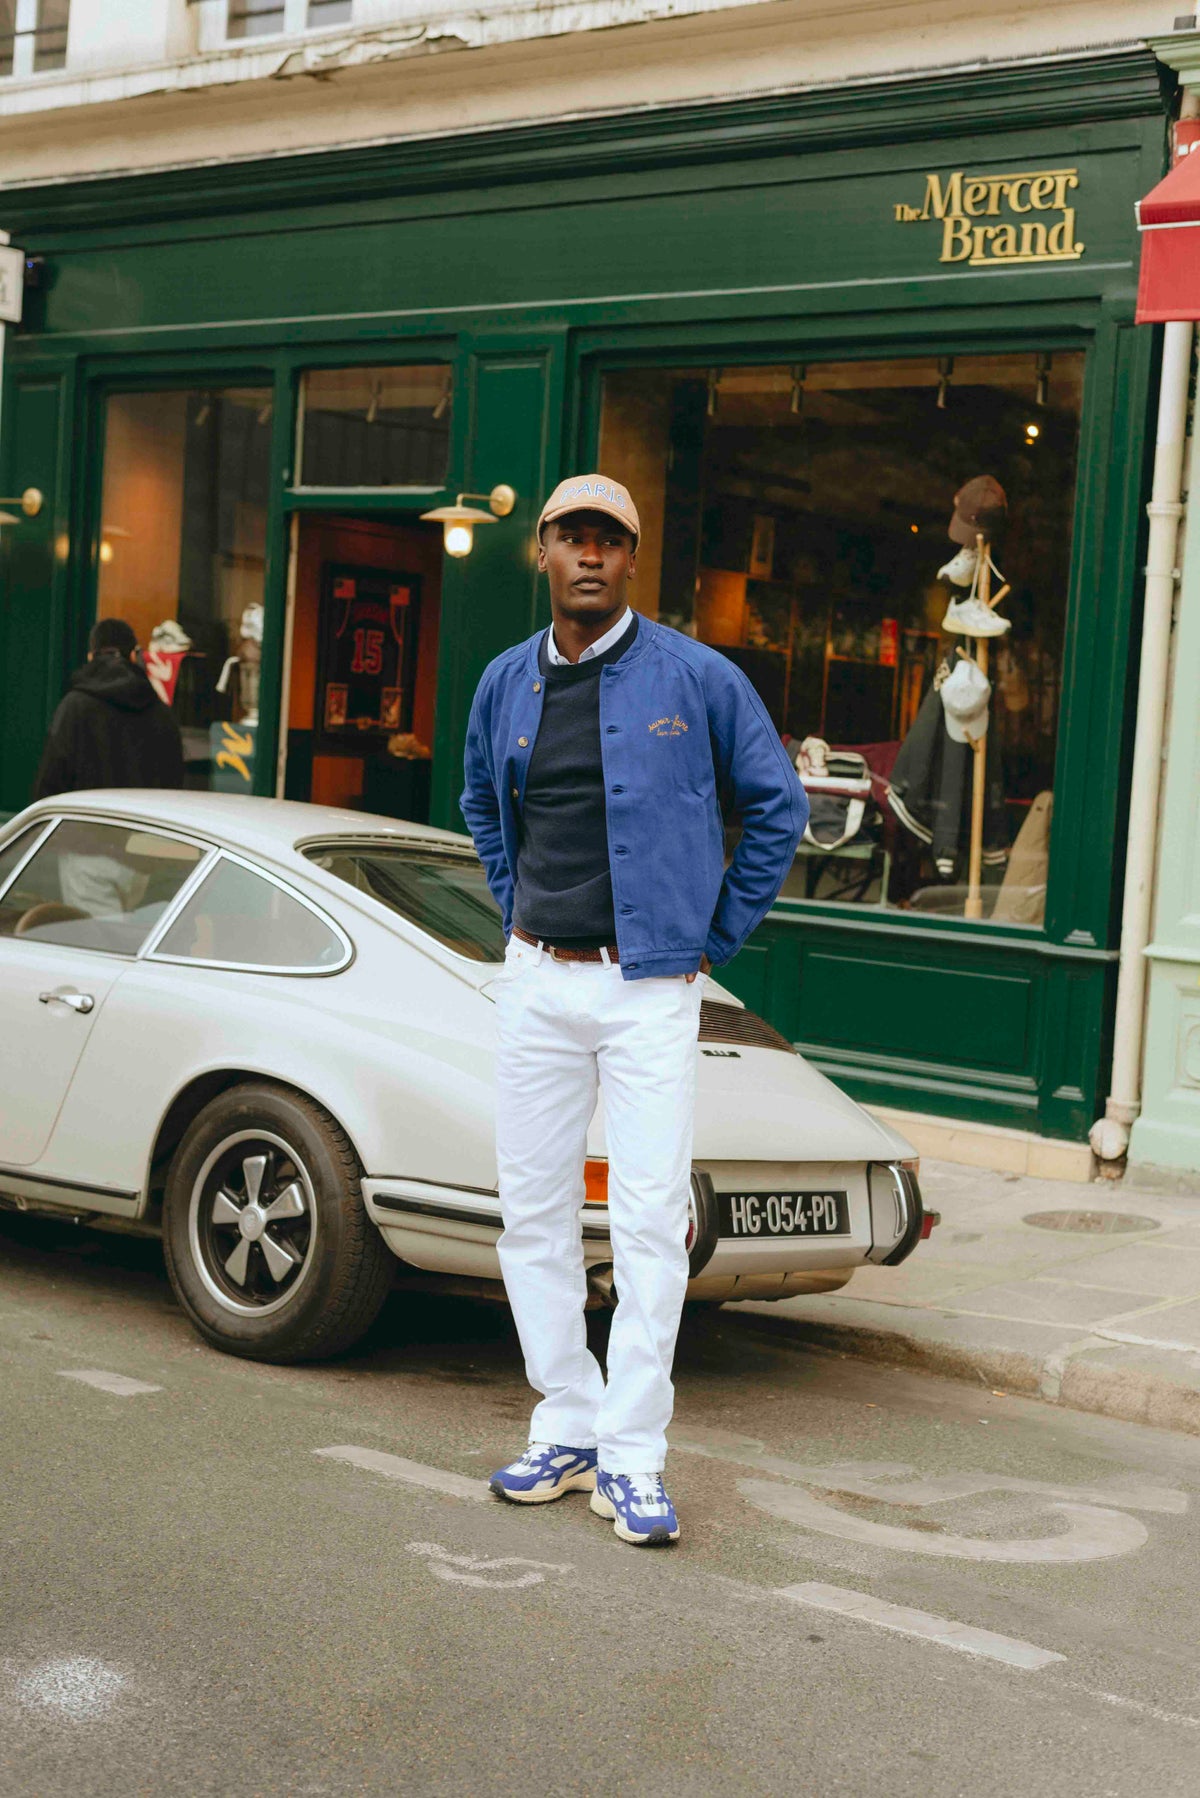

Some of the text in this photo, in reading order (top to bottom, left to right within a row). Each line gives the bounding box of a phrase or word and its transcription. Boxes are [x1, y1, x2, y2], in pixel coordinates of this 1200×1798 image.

[893, 170, 1079, 222] The Mercer
[351, 628, 384, 675] 15
[730, 1195, 838, 1234] HG-054-PD
